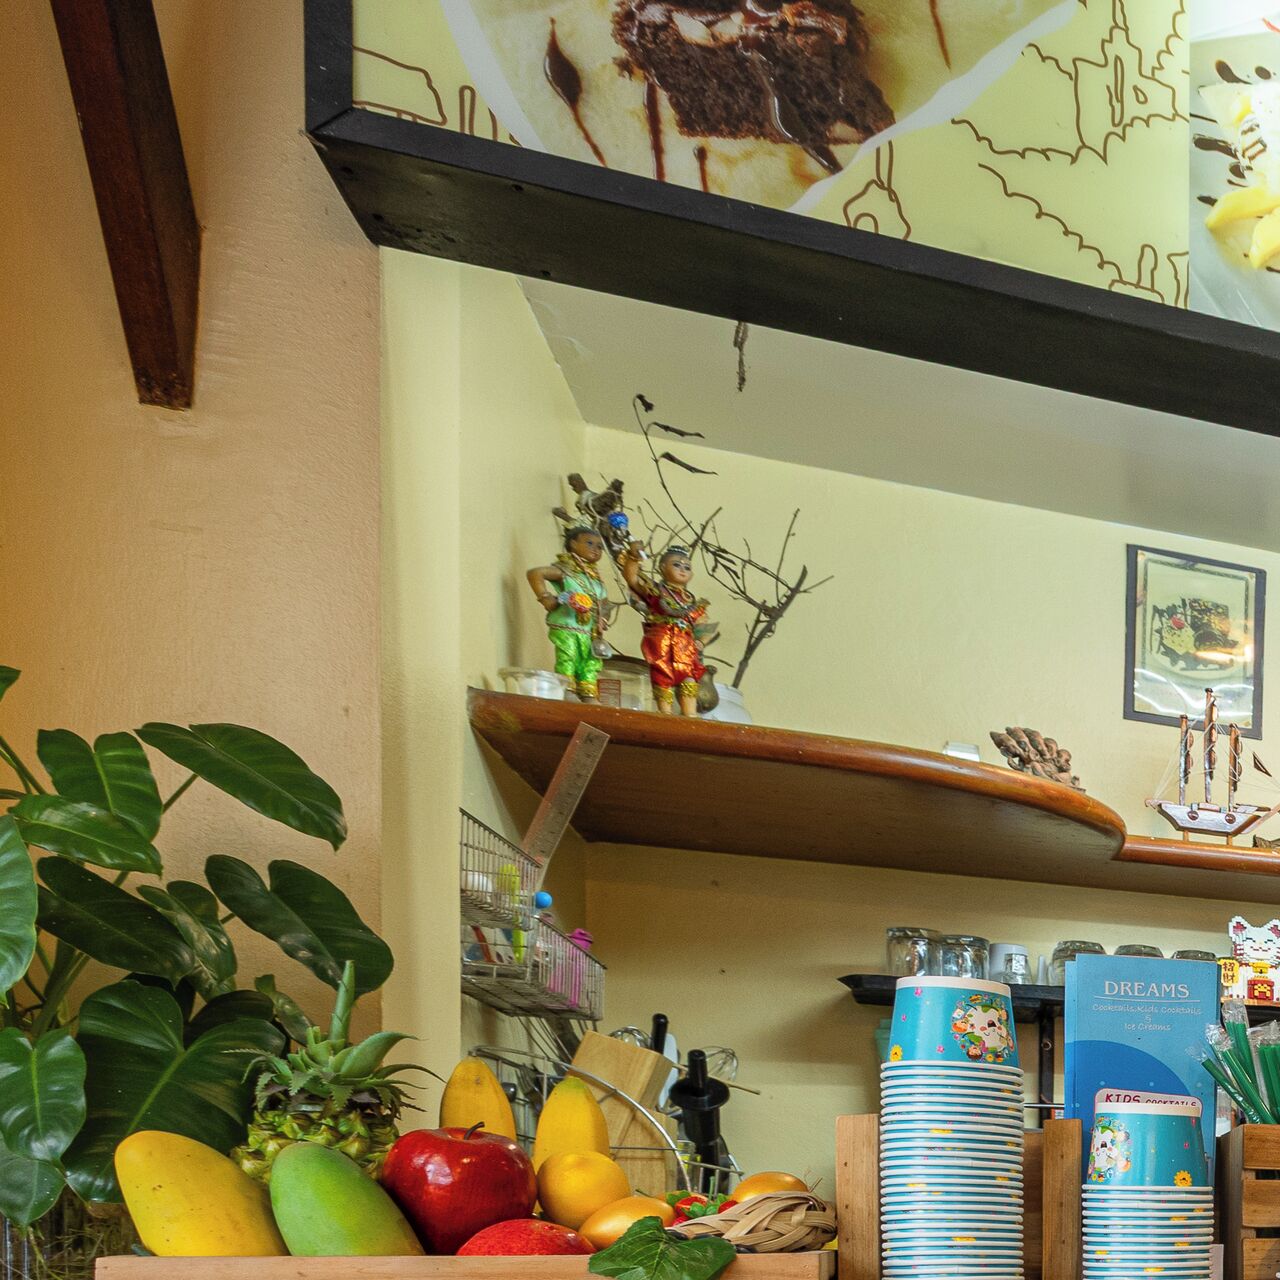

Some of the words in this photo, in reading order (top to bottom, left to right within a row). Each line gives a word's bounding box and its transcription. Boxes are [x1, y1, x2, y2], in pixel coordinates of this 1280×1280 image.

[1104, 980, 1190, 998] DREAMS
[1125, 1023, 1136, 1031] Ice
[1138, 1023, 1171, 1031] Creams
